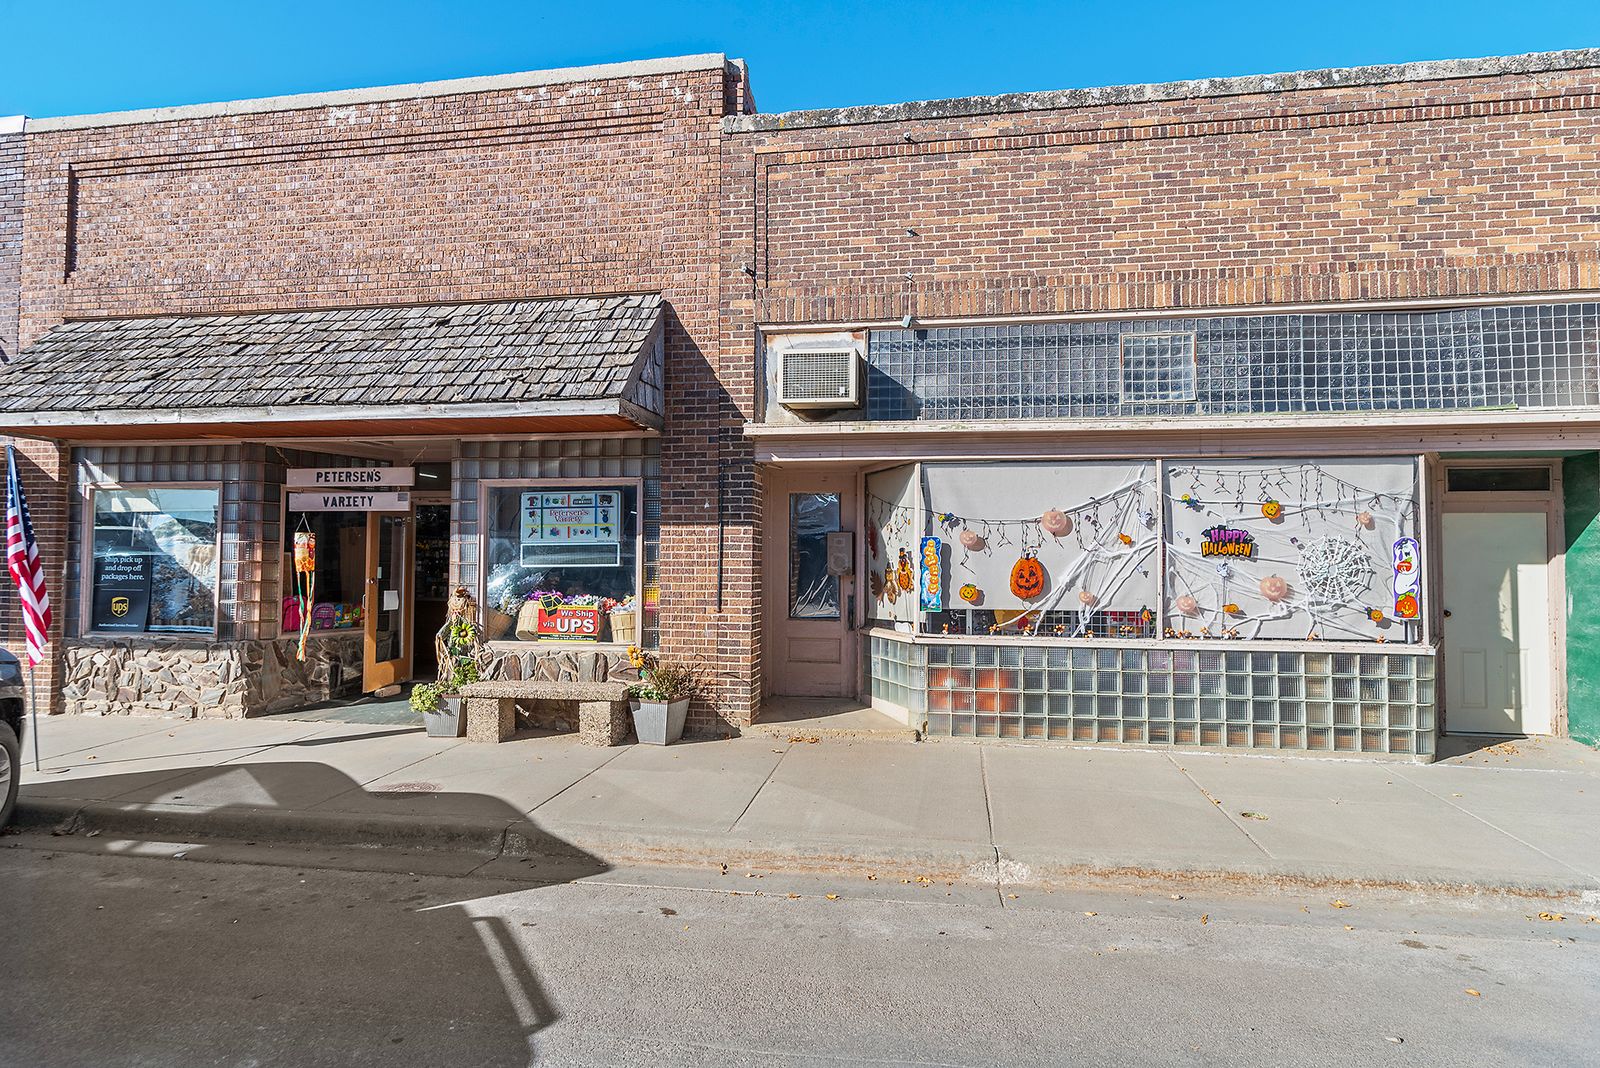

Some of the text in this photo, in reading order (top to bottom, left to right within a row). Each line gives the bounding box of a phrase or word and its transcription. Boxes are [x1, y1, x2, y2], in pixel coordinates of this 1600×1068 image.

[316, 469, 381, 483] PETERSEN'S
[323, 496, 374, 507] VARIETY
[1210, 529, 1248, 543] HAPPY
[1201, 541, 1252, 556] HALLOWEEN
[119, 556, 134, 564] pick
[101, 573, 128, 581] packages
[113, 603, 128, 614] ups
[575, 610, 594, 618] Ship
[556, 618, 595, 633] UPS
